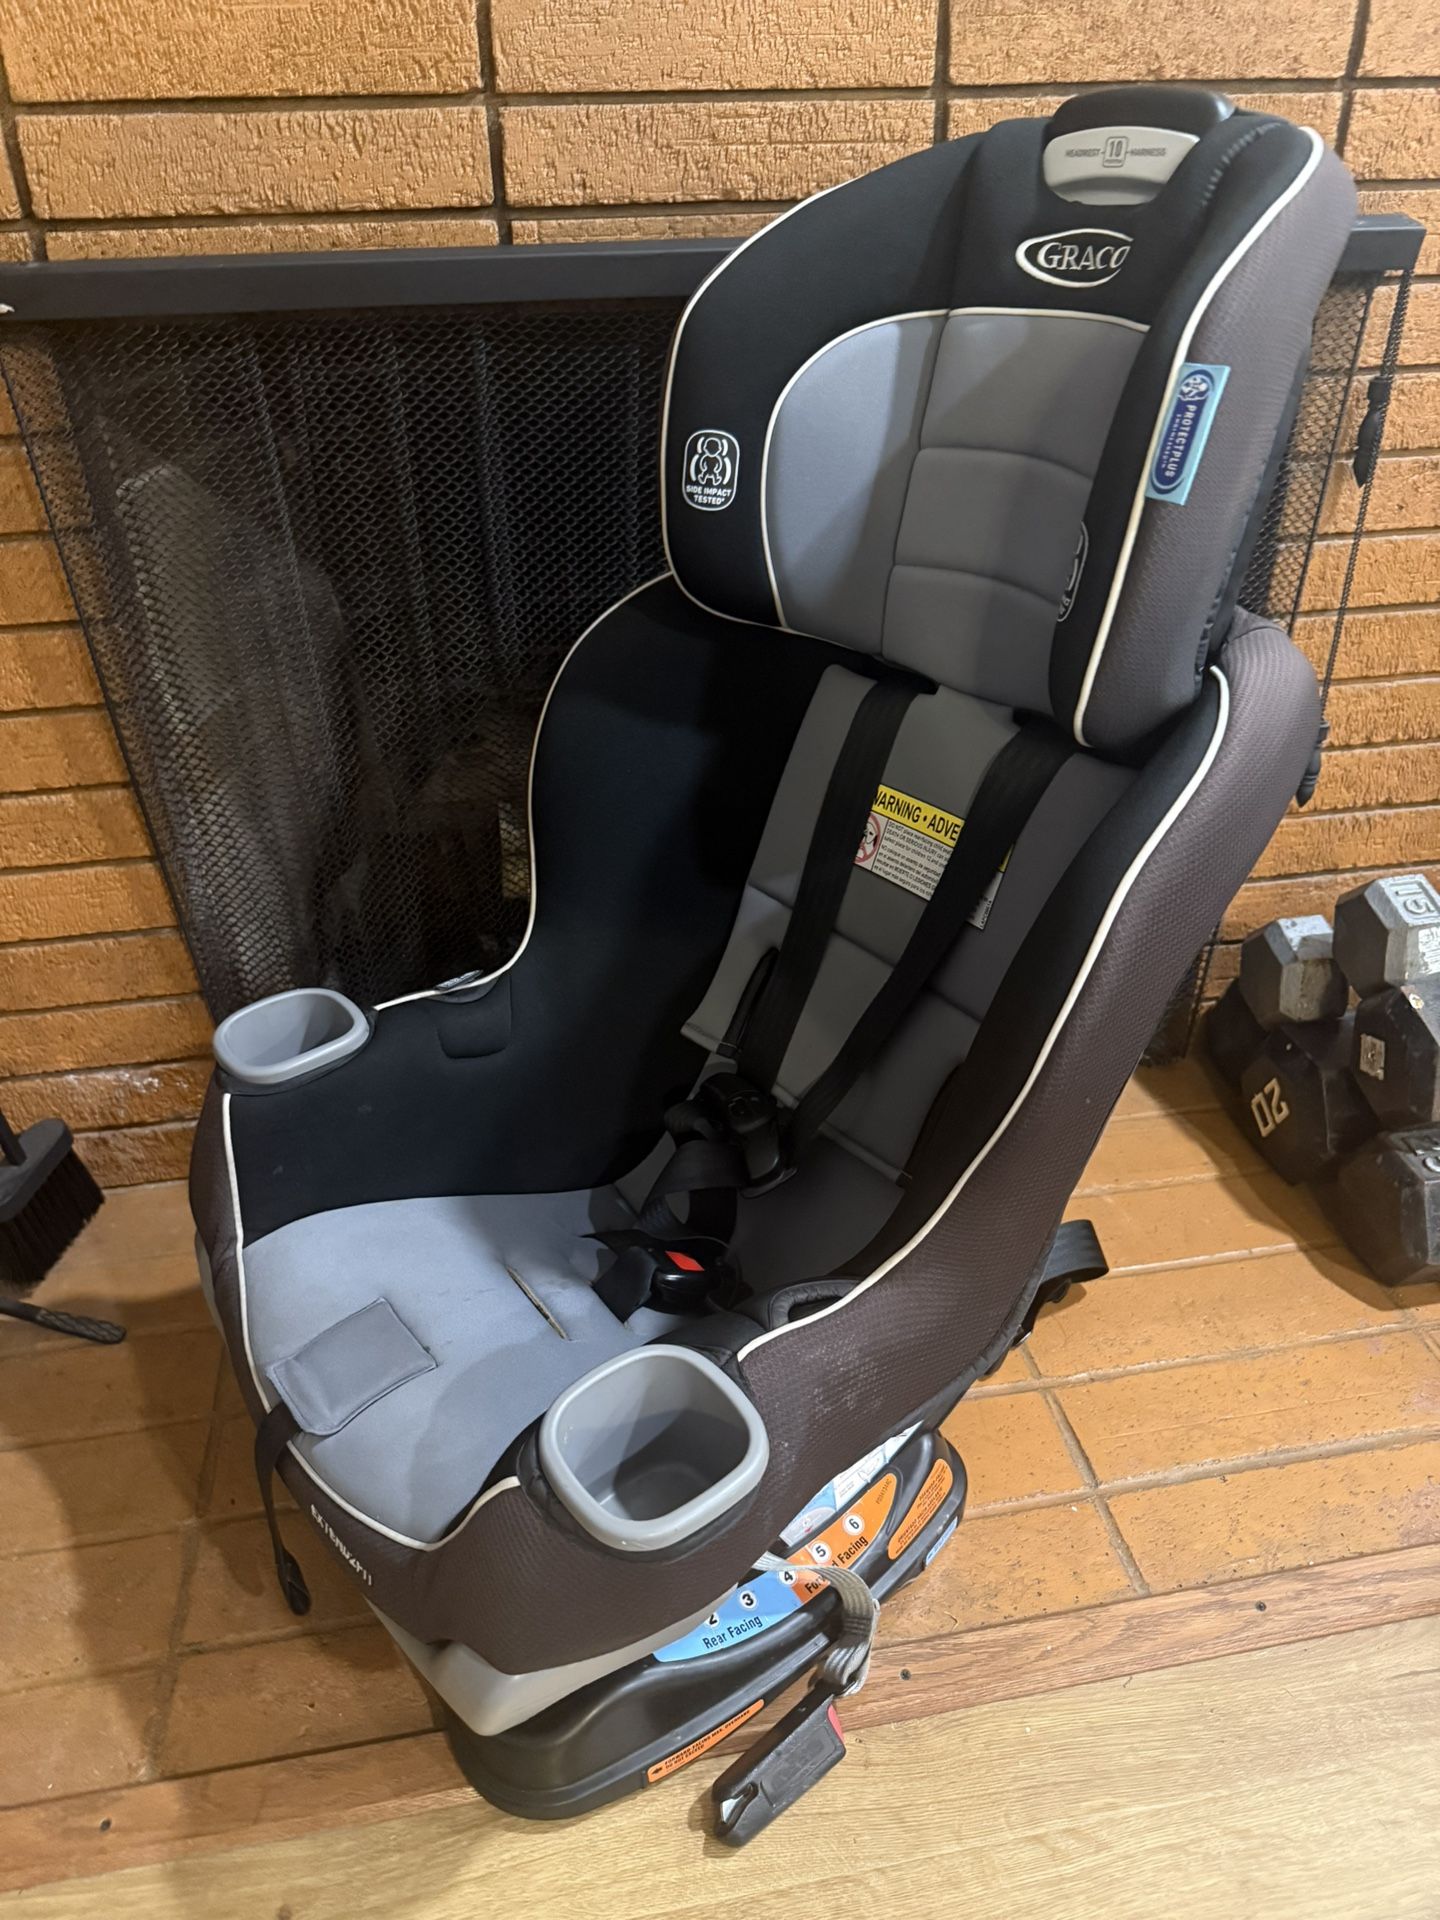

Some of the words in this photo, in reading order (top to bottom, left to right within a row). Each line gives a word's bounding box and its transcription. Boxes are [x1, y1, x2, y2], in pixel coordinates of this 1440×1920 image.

[1109, 139, 1123, 158] 10
[1036, 242, 1131, 271] GRACO
[686, 485, 701, 494] SIDE
[704, 487, 732, 497] IMPACT
[927, 814, 961, 841] ADVE
[1394, 887, 1436, 915] 15
[1251, 1078, 1290, 1137] 20
[849, 1518, 860, 1530] 6
[815, 1545, 827, 1558] 5
[837, 1536, 869, 1564] Facing
[784, 1571, 794, 1582] 4
[742, 1593, 754, 1606] 3
[702, 1630, 728, 1649] Rear
[727, 1616, 764, 1639] Facing
